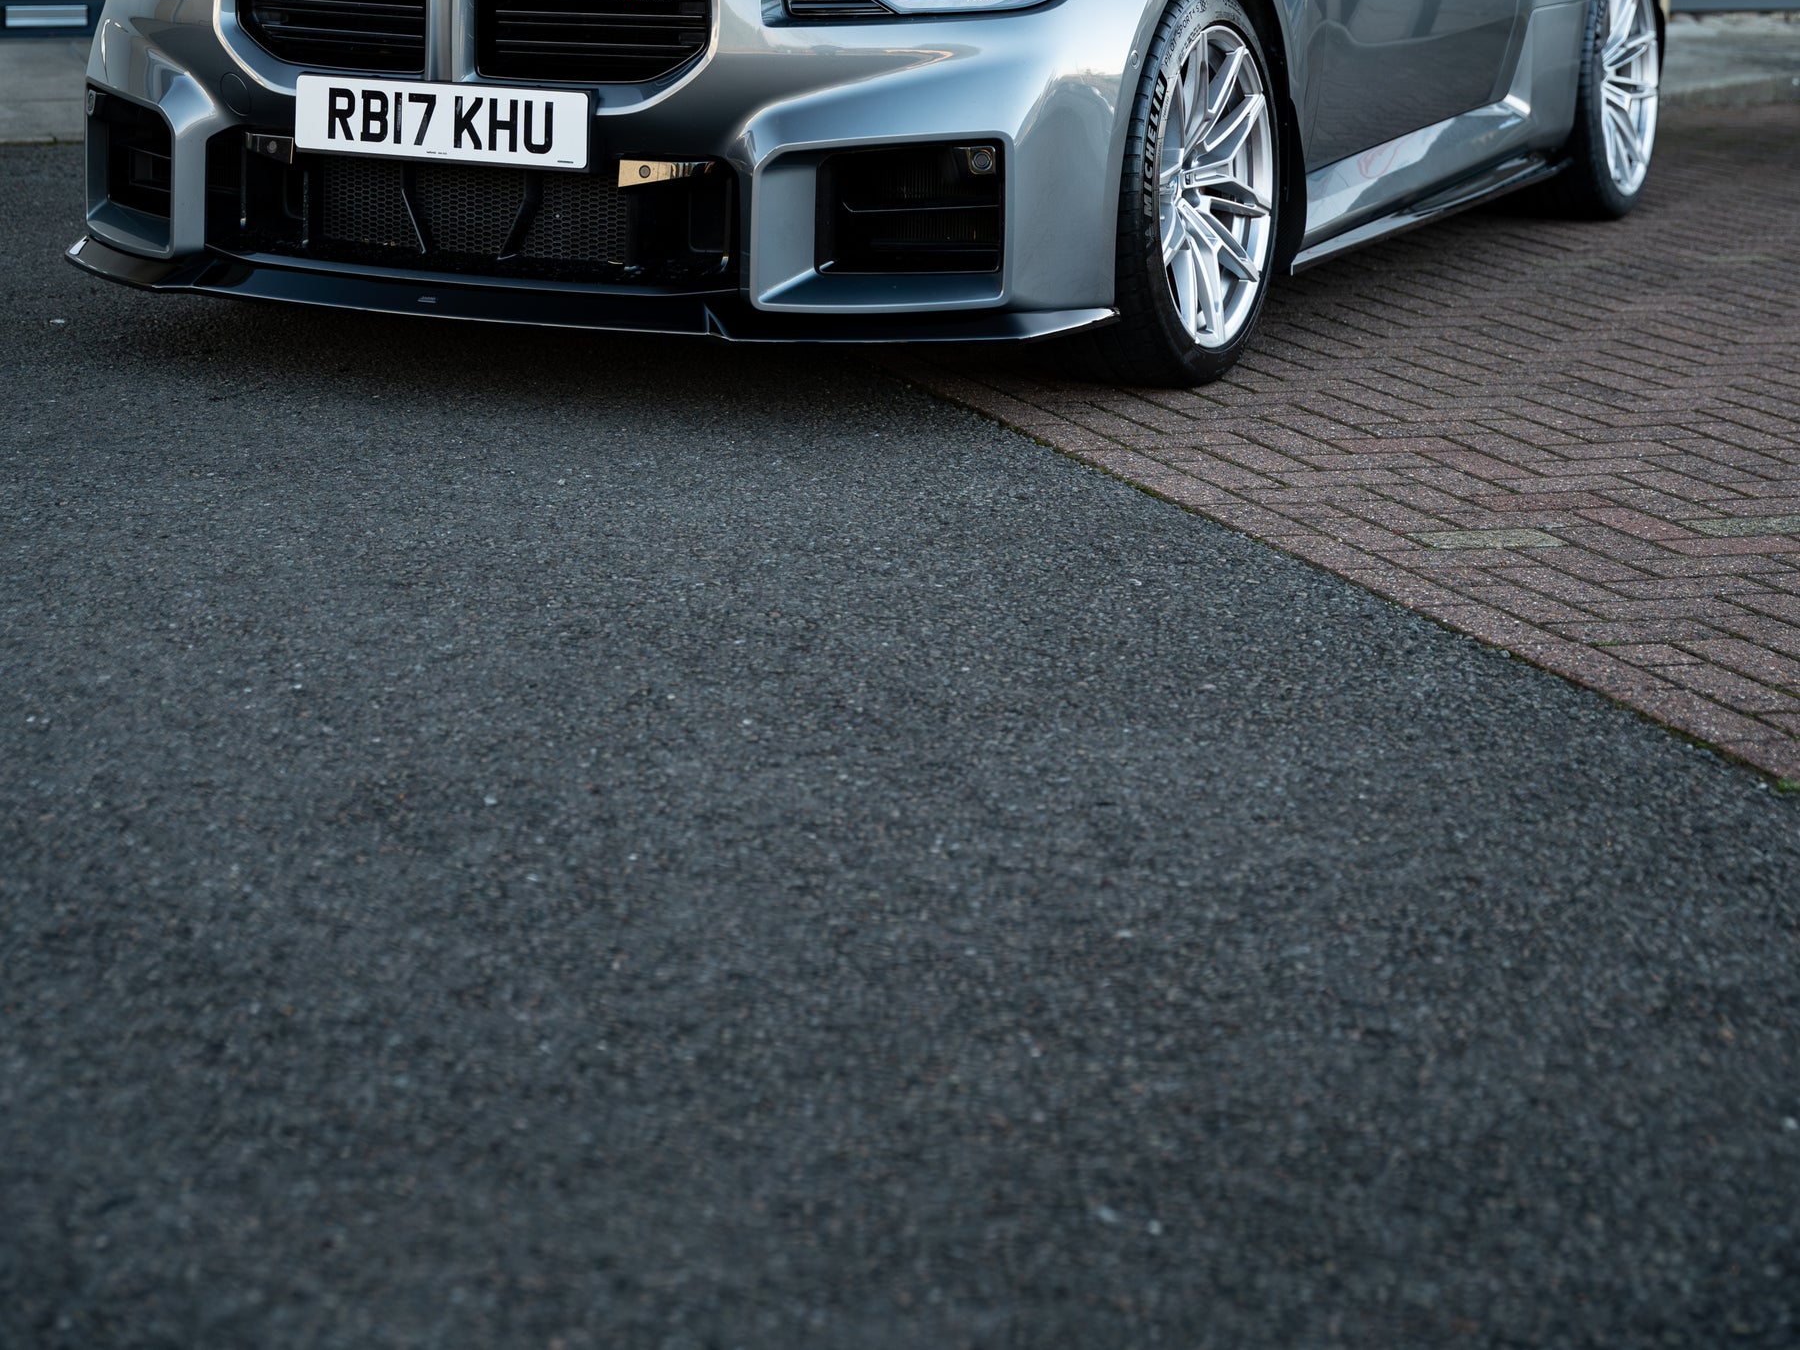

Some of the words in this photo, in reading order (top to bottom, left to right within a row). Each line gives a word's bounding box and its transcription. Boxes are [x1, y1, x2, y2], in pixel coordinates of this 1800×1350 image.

[1165, 41, 1177, 67] PILOT
[1178, 11, 1193, 38] SPORT
[328, 87, 437, 146] RB17
[453, 95, 554, 154] KHU
[1144, 76, 1166, 217] MICHELIN
